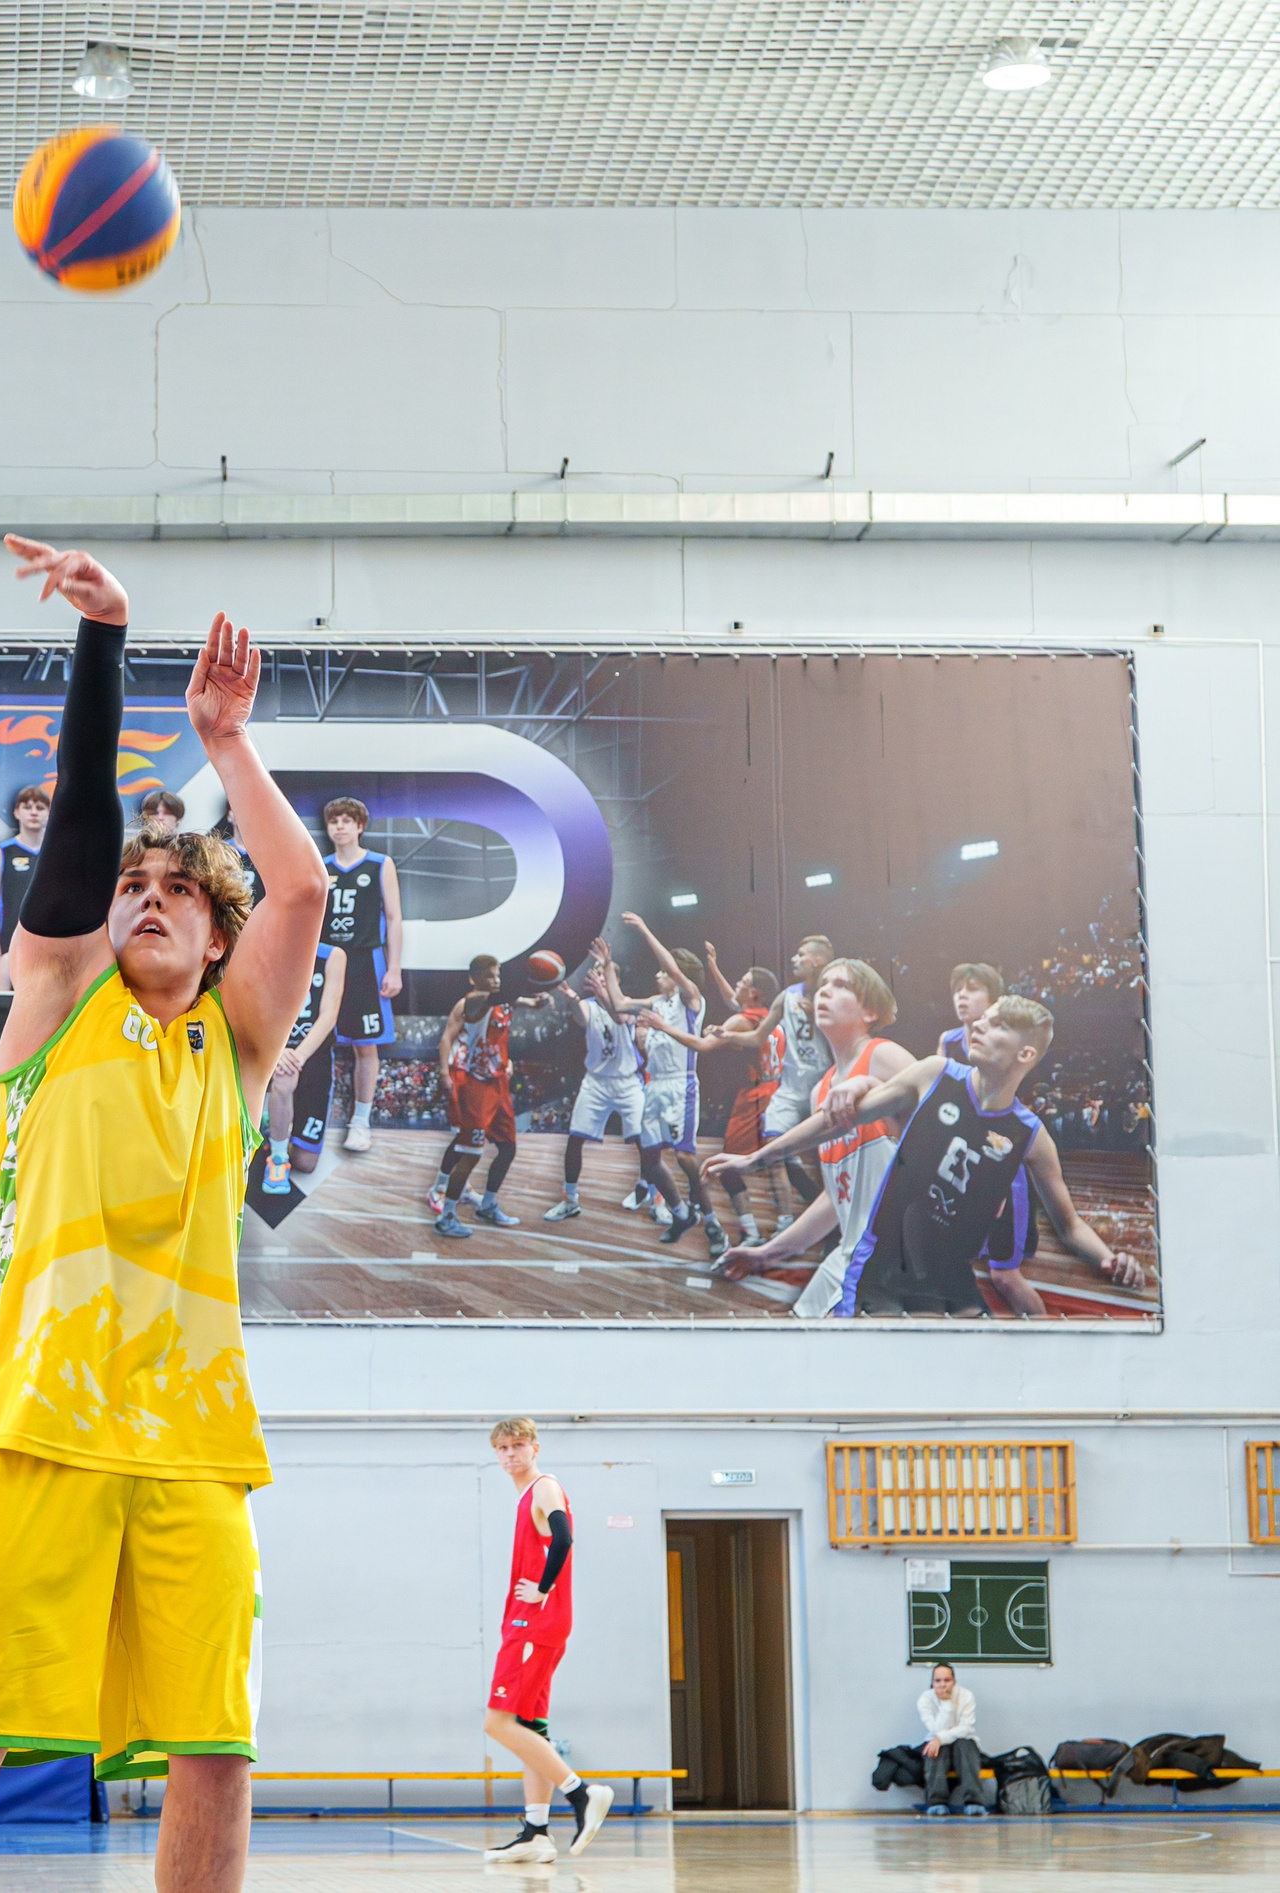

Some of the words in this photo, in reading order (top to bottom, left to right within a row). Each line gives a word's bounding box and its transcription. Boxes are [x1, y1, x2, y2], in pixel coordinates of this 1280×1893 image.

[332, 888, 358, 915] 15
[362, 1013, 381, 1035] 15
[302, 1116, 324, 1140] 12
